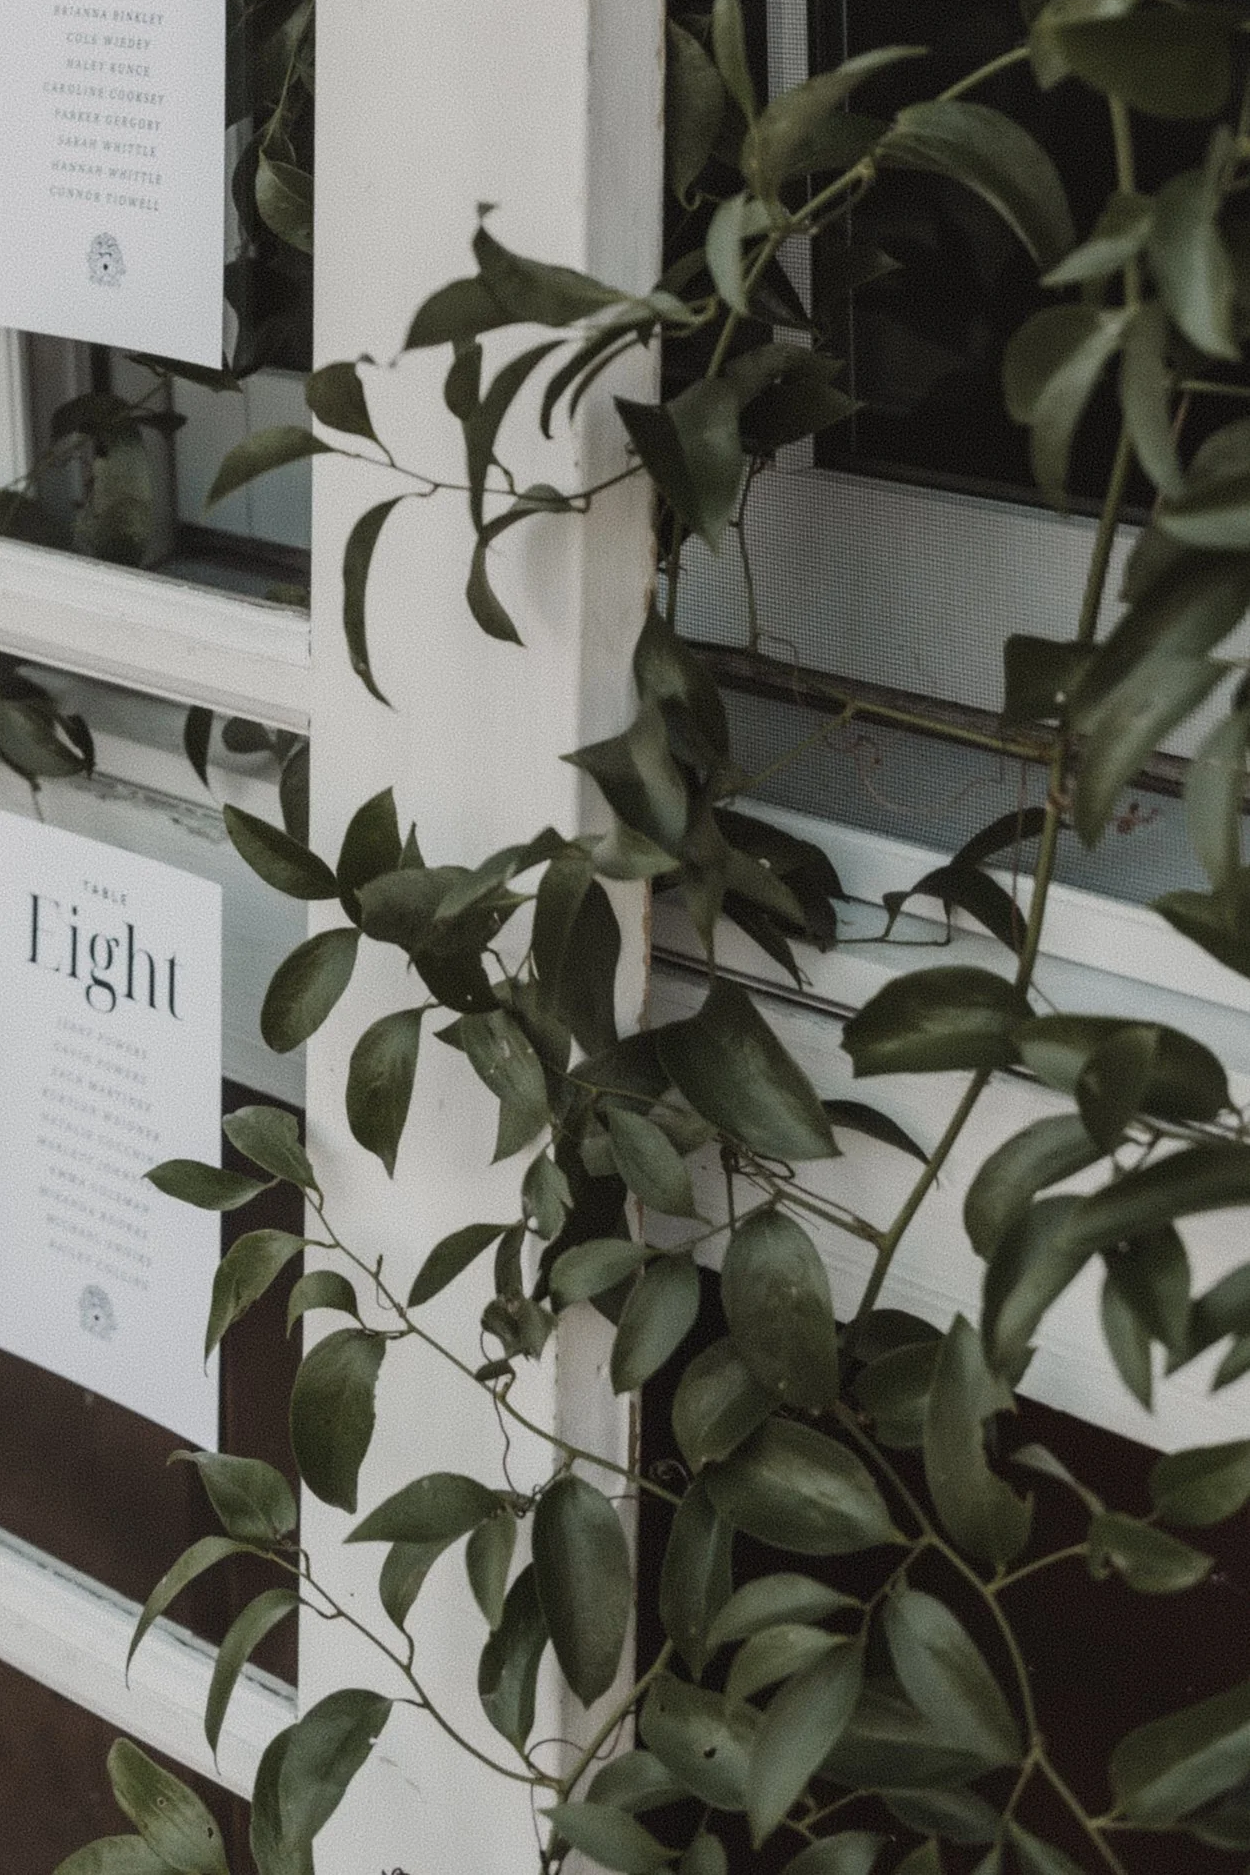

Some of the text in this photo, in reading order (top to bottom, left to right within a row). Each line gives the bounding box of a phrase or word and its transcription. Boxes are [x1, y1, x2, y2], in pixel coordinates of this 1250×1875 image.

[43, 82, 104, 98] CAROLINE
[103, 141, 157, 158] WHITTLE
[51, 160, 162, 185] HANNAH WHITTLE
[49, 185, 159, 212] CONNOR TIDWELL
[82, 879, 128, 907] TABLE
[26, 893, 184, 1021] Eight
